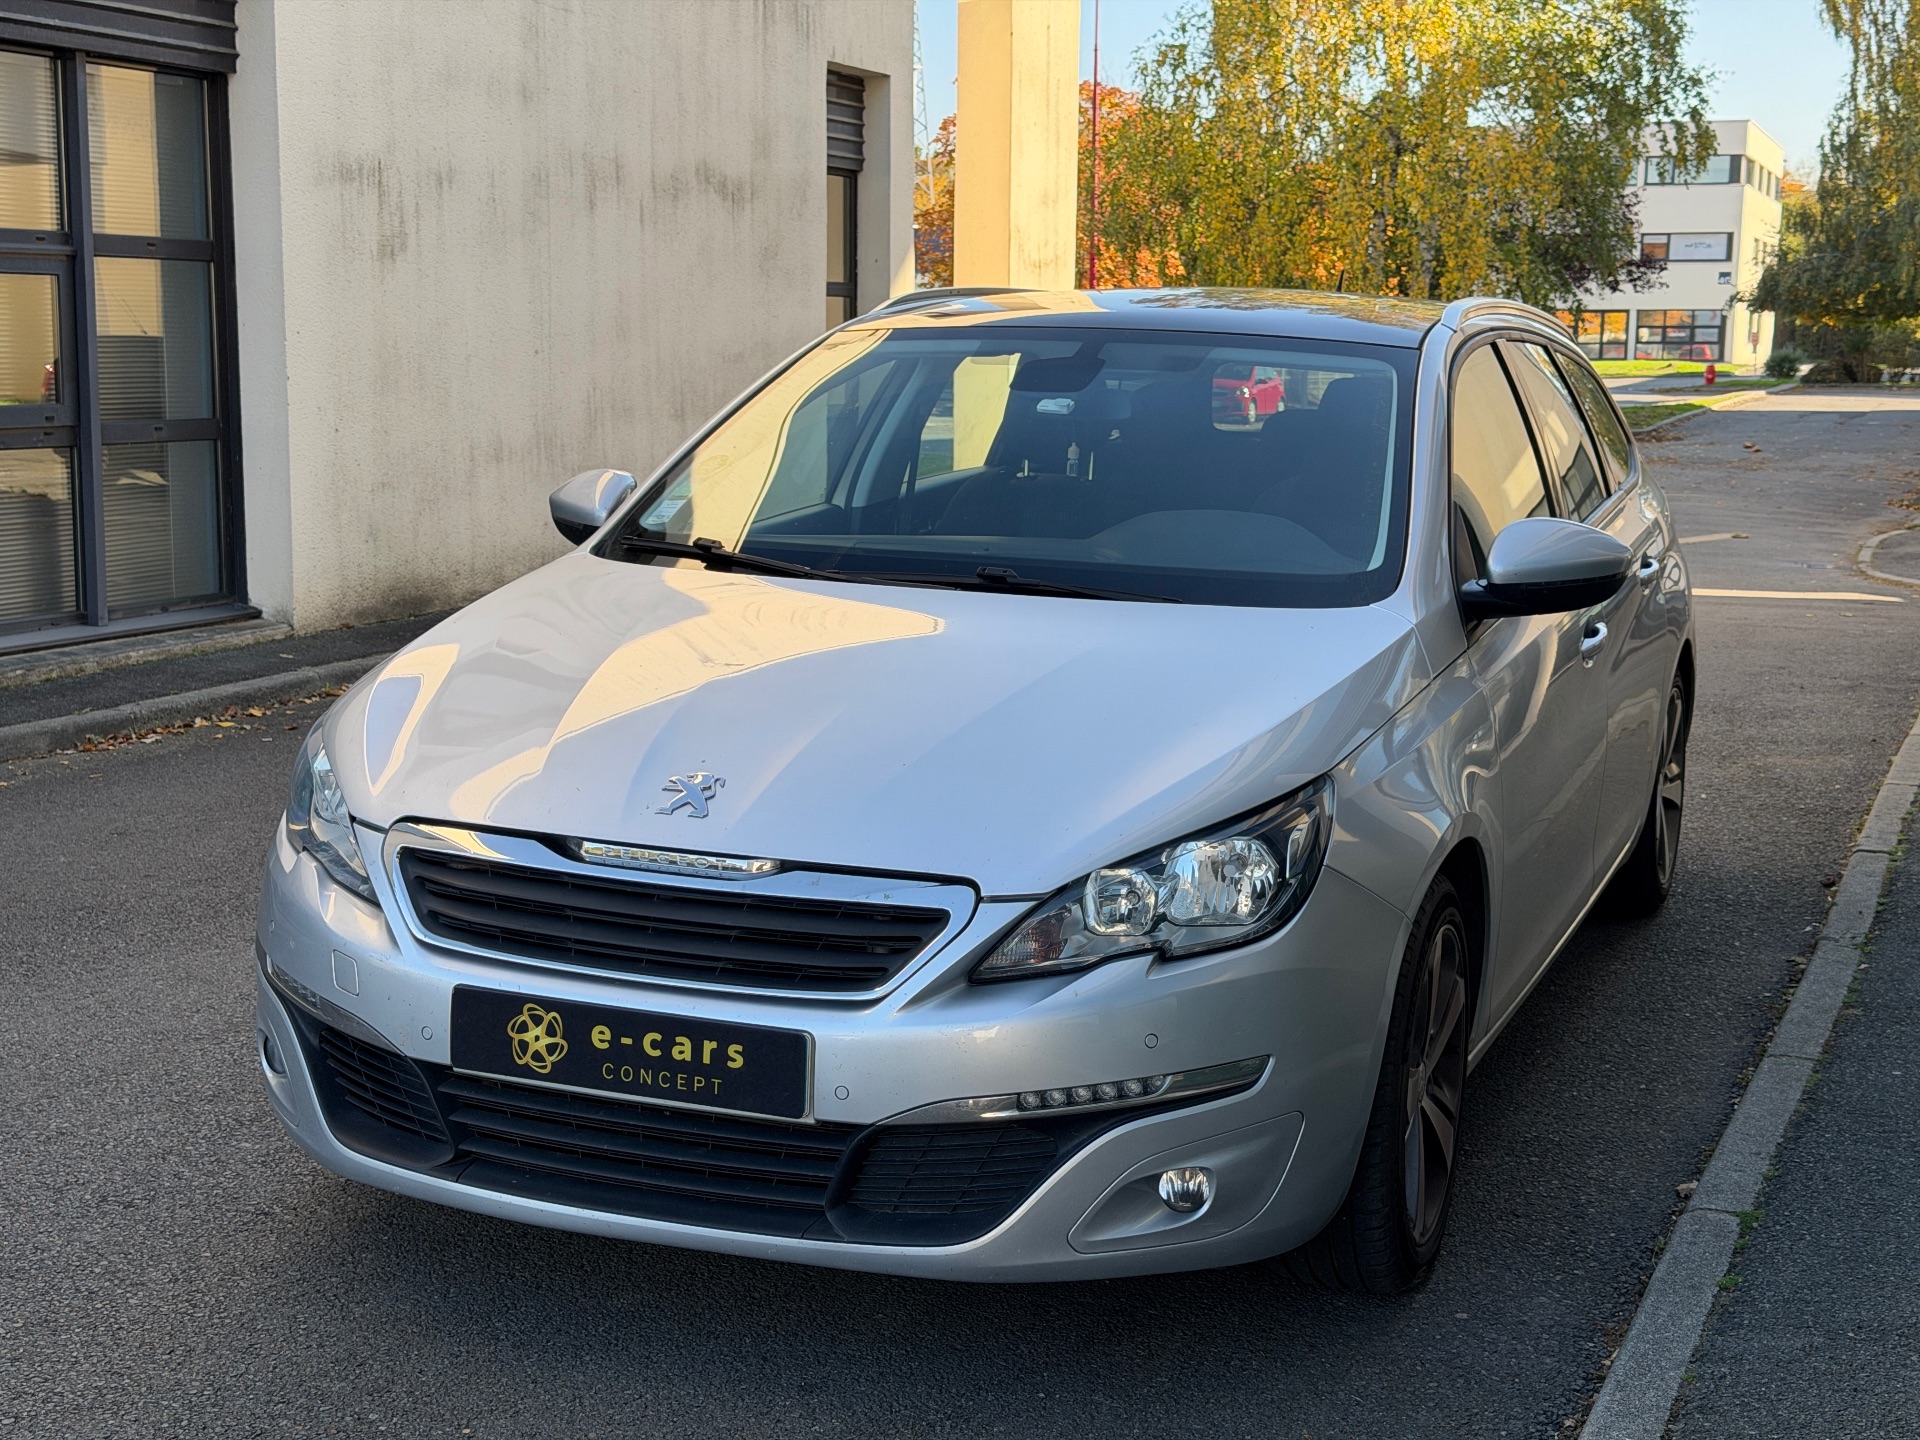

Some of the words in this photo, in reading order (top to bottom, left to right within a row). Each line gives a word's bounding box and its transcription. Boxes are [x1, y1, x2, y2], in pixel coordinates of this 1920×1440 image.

[602, 846, 727, 870] PEUGEOT
[591, 1024, 744, 1069] e-cars
[602, 1063, 723, 1095] CONCEPT
